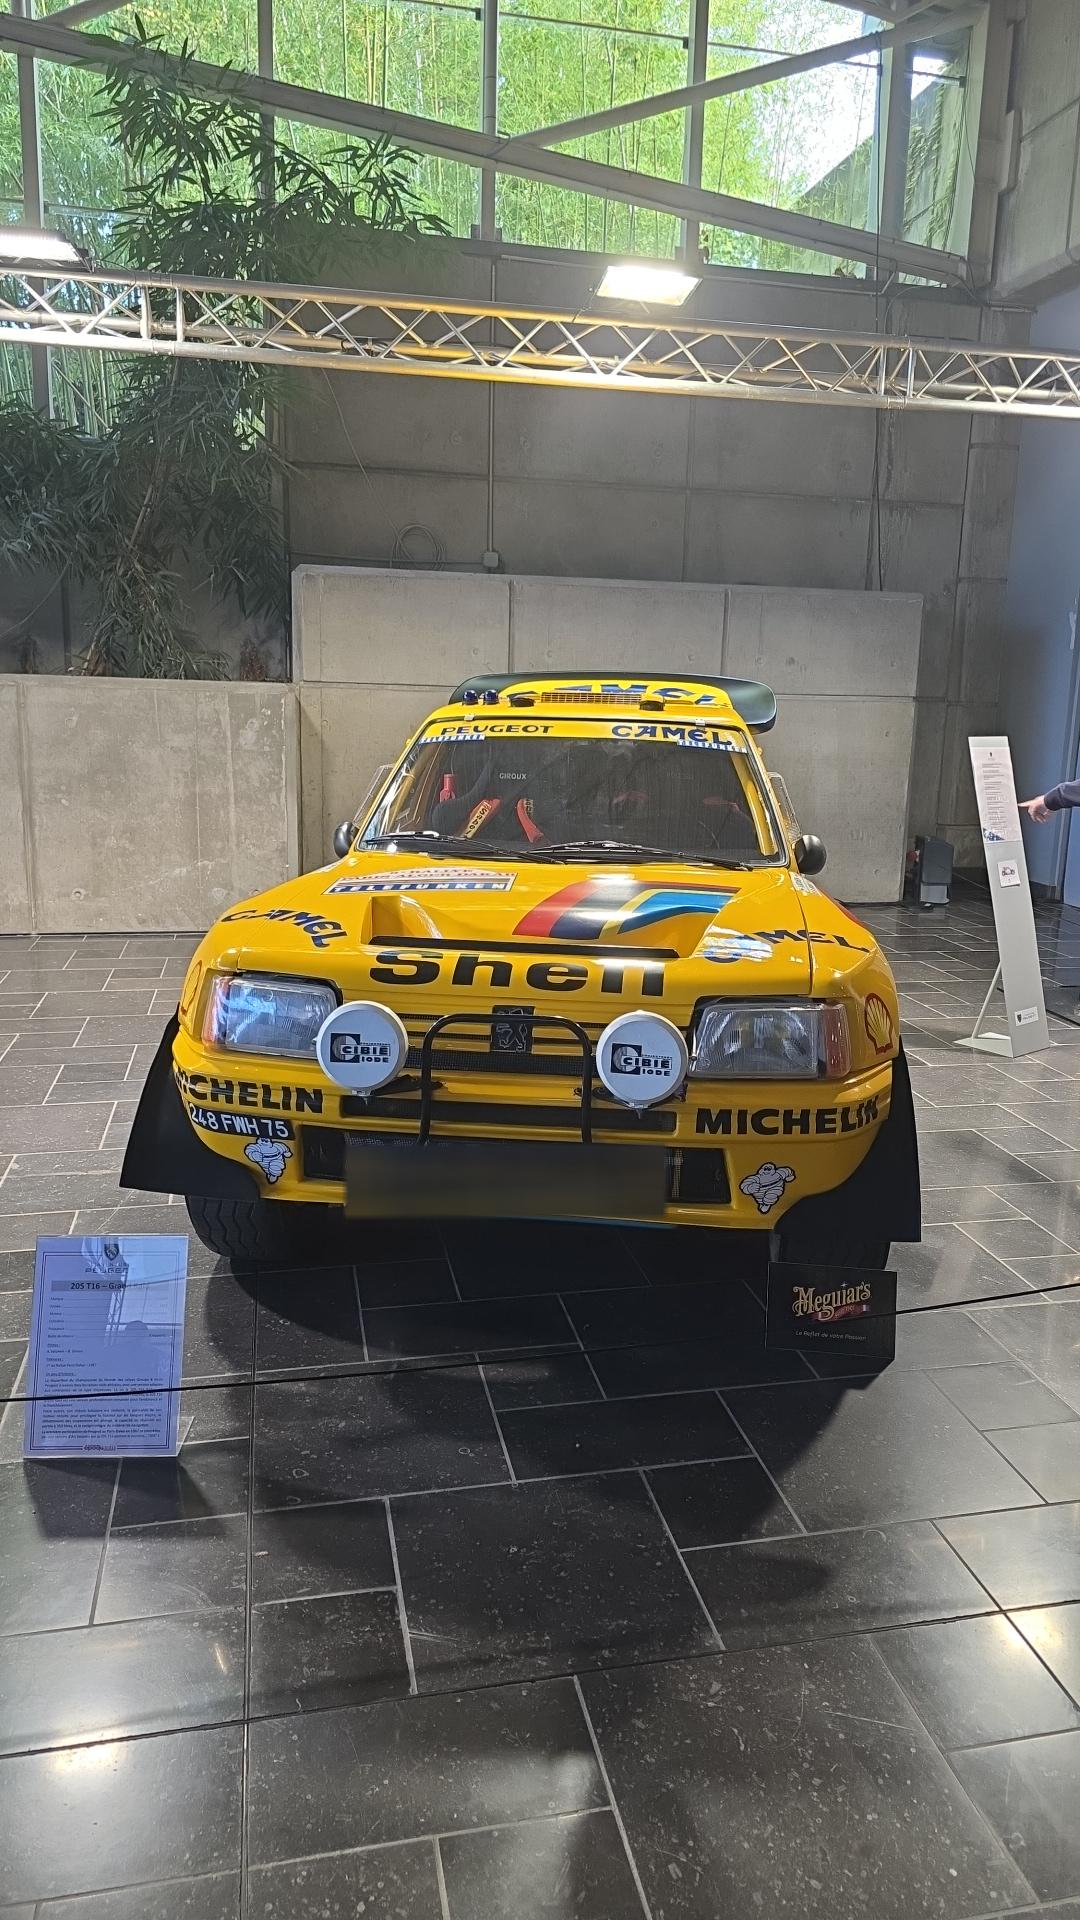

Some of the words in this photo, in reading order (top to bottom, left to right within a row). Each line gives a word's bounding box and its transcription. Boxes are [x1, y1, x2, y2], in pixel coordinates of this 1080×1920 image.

[441, 724, 555, 735] PEUGEOT
[611, 725, 733, 745] CAMEL
[499, 772, 527, 780] GIROUX
[333, 882, 508, 893] TELEFUNKEN
[222, 908, 348, 948] CAMEL
[370, 950, 665, 997] Shell
[642, 1068, 671, 1077] IODE
[189, 1104, 219, 1130] 248
[220, 1113, 260, 1136] FWH
[261, 1119, 289, 1138] 75
[695, 1095, 880, 1136] MICHELIN
[70, 1282, 84, 1290] 205
[86, 1282, 100, 1290] T16
[792, 1281, 872, 1321] Meguiar's
